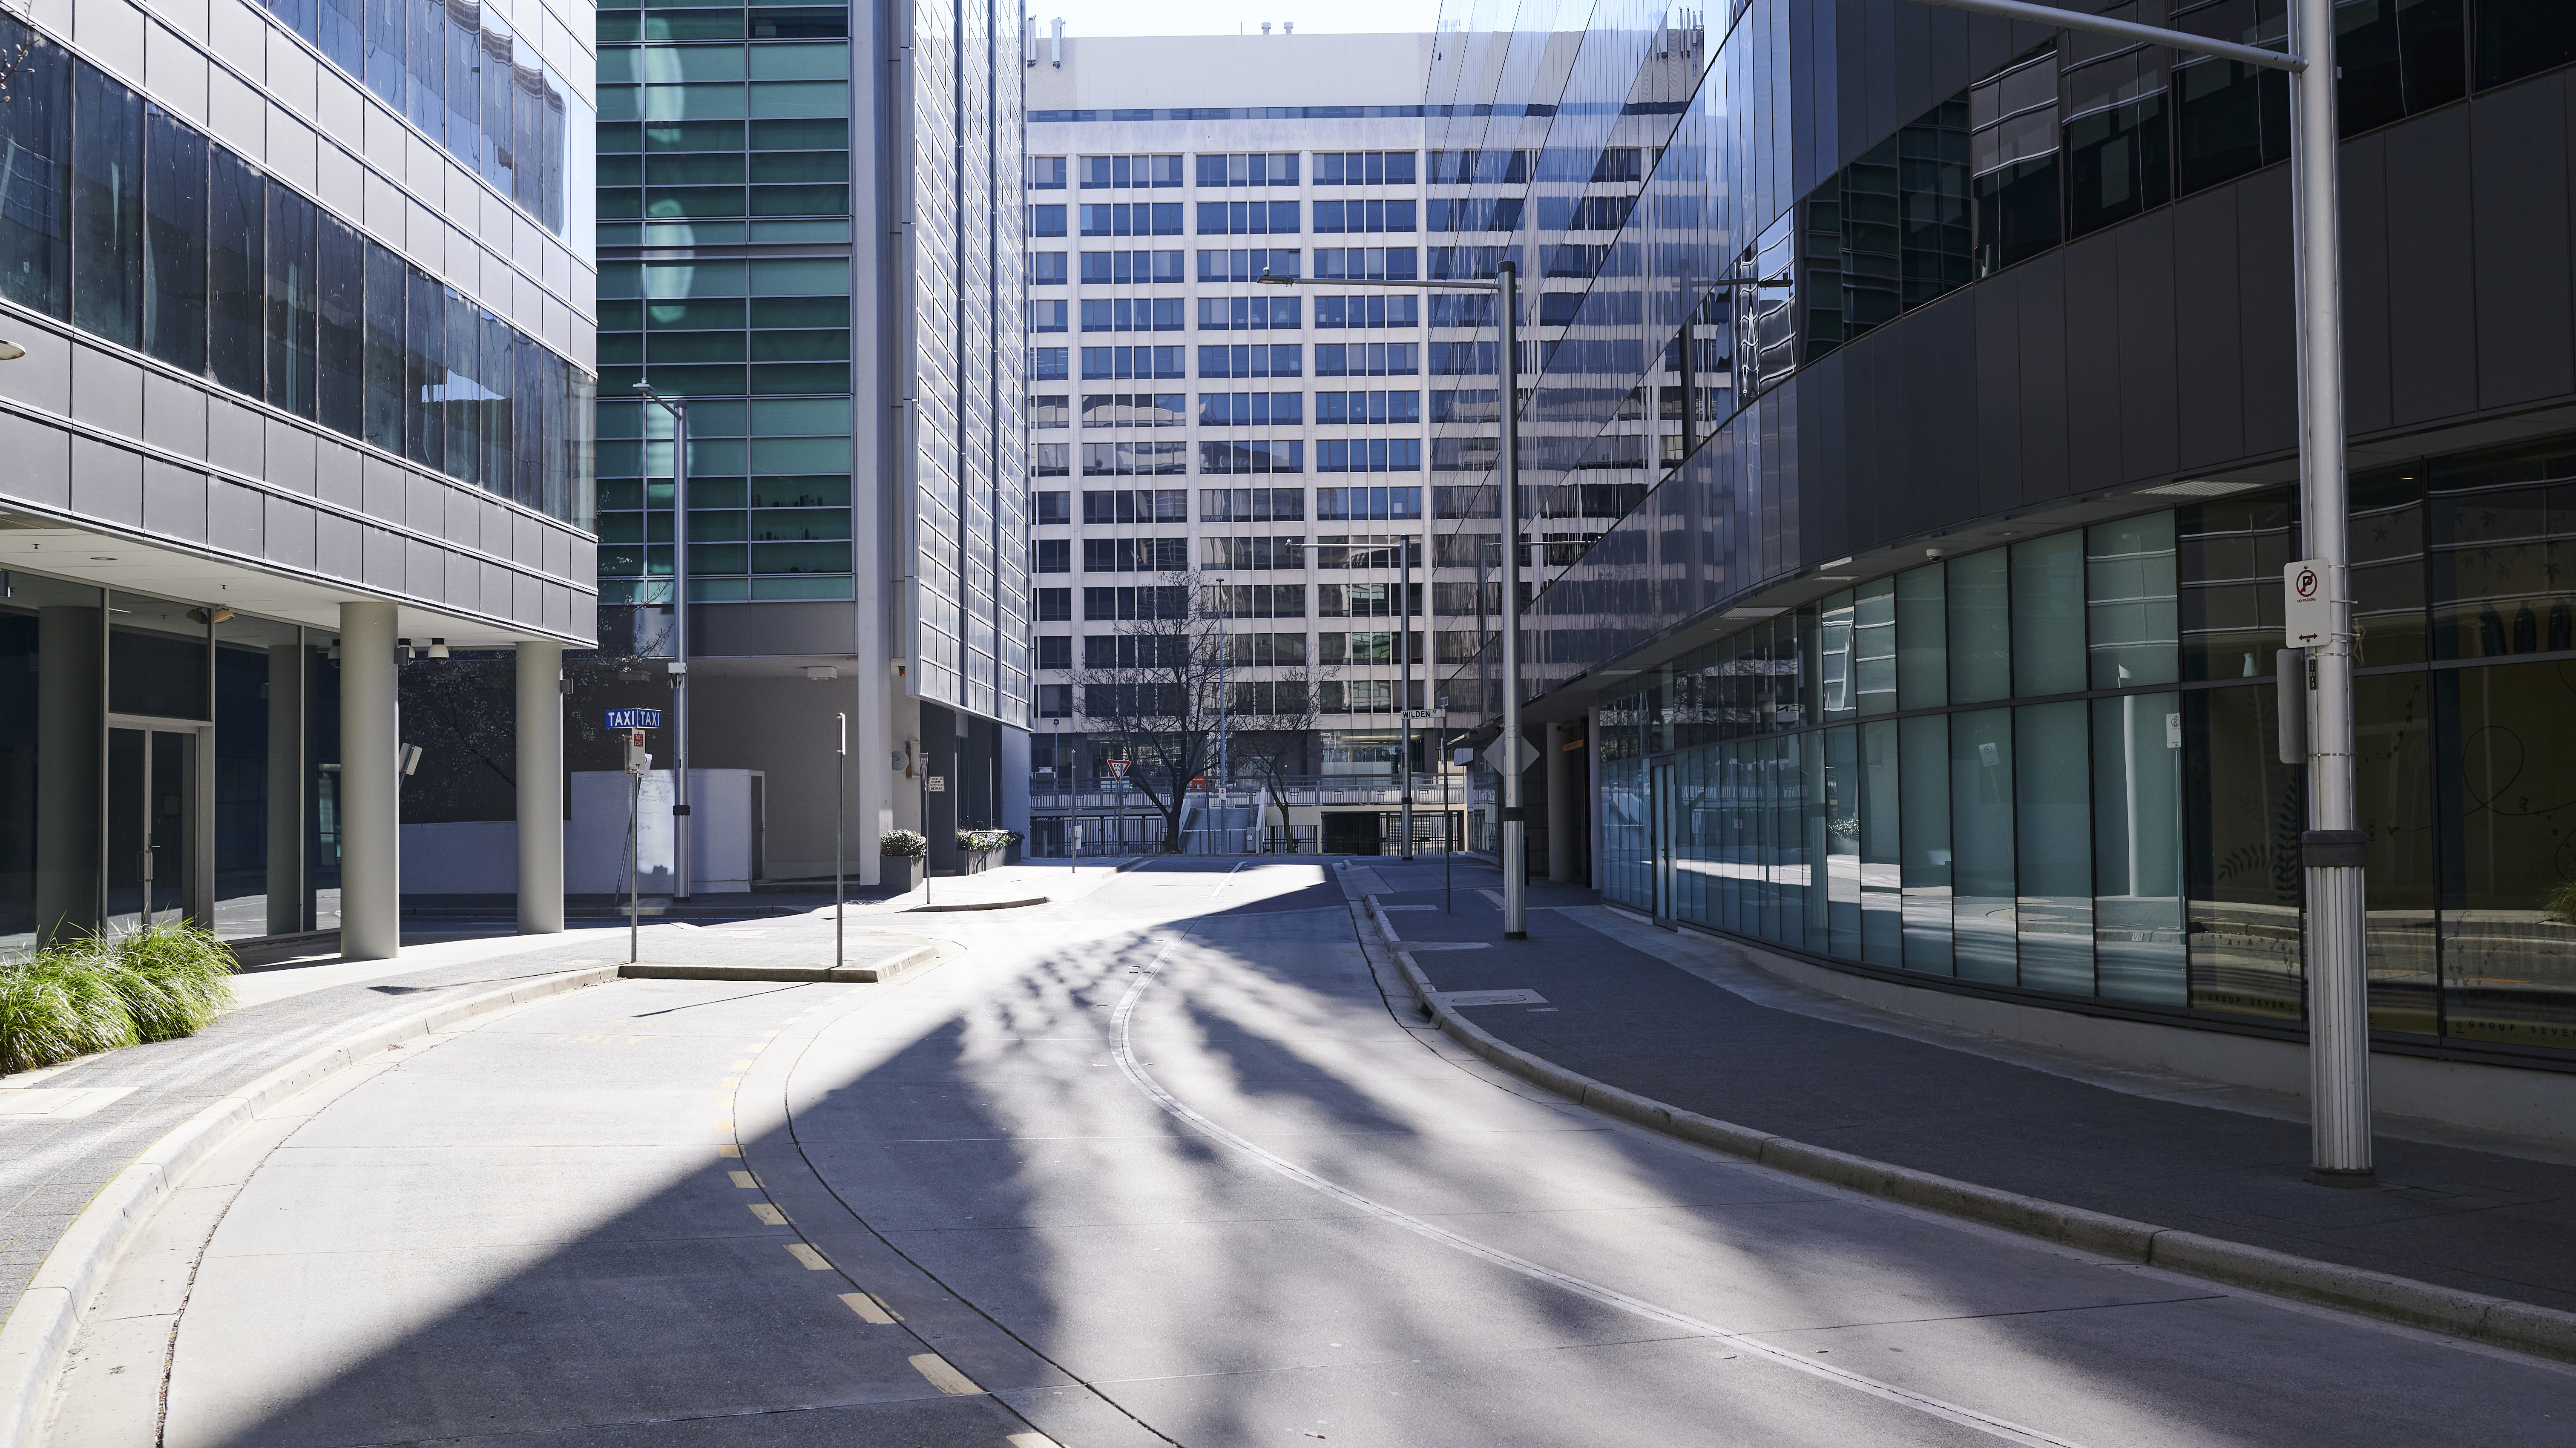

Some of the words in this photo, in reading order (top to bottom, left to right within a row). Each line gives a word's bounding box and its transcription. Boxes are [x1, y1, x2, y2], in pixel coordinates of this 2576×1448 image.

[608, 711, 634, 726] TAXI
[641, 712, 659, 726] TAXI
[2208, 994, 2240, 1004] GROUP
[2251, 999, 2284, 1008] SEVEN
[2469, 1021, 2515, 1031] GROUP
